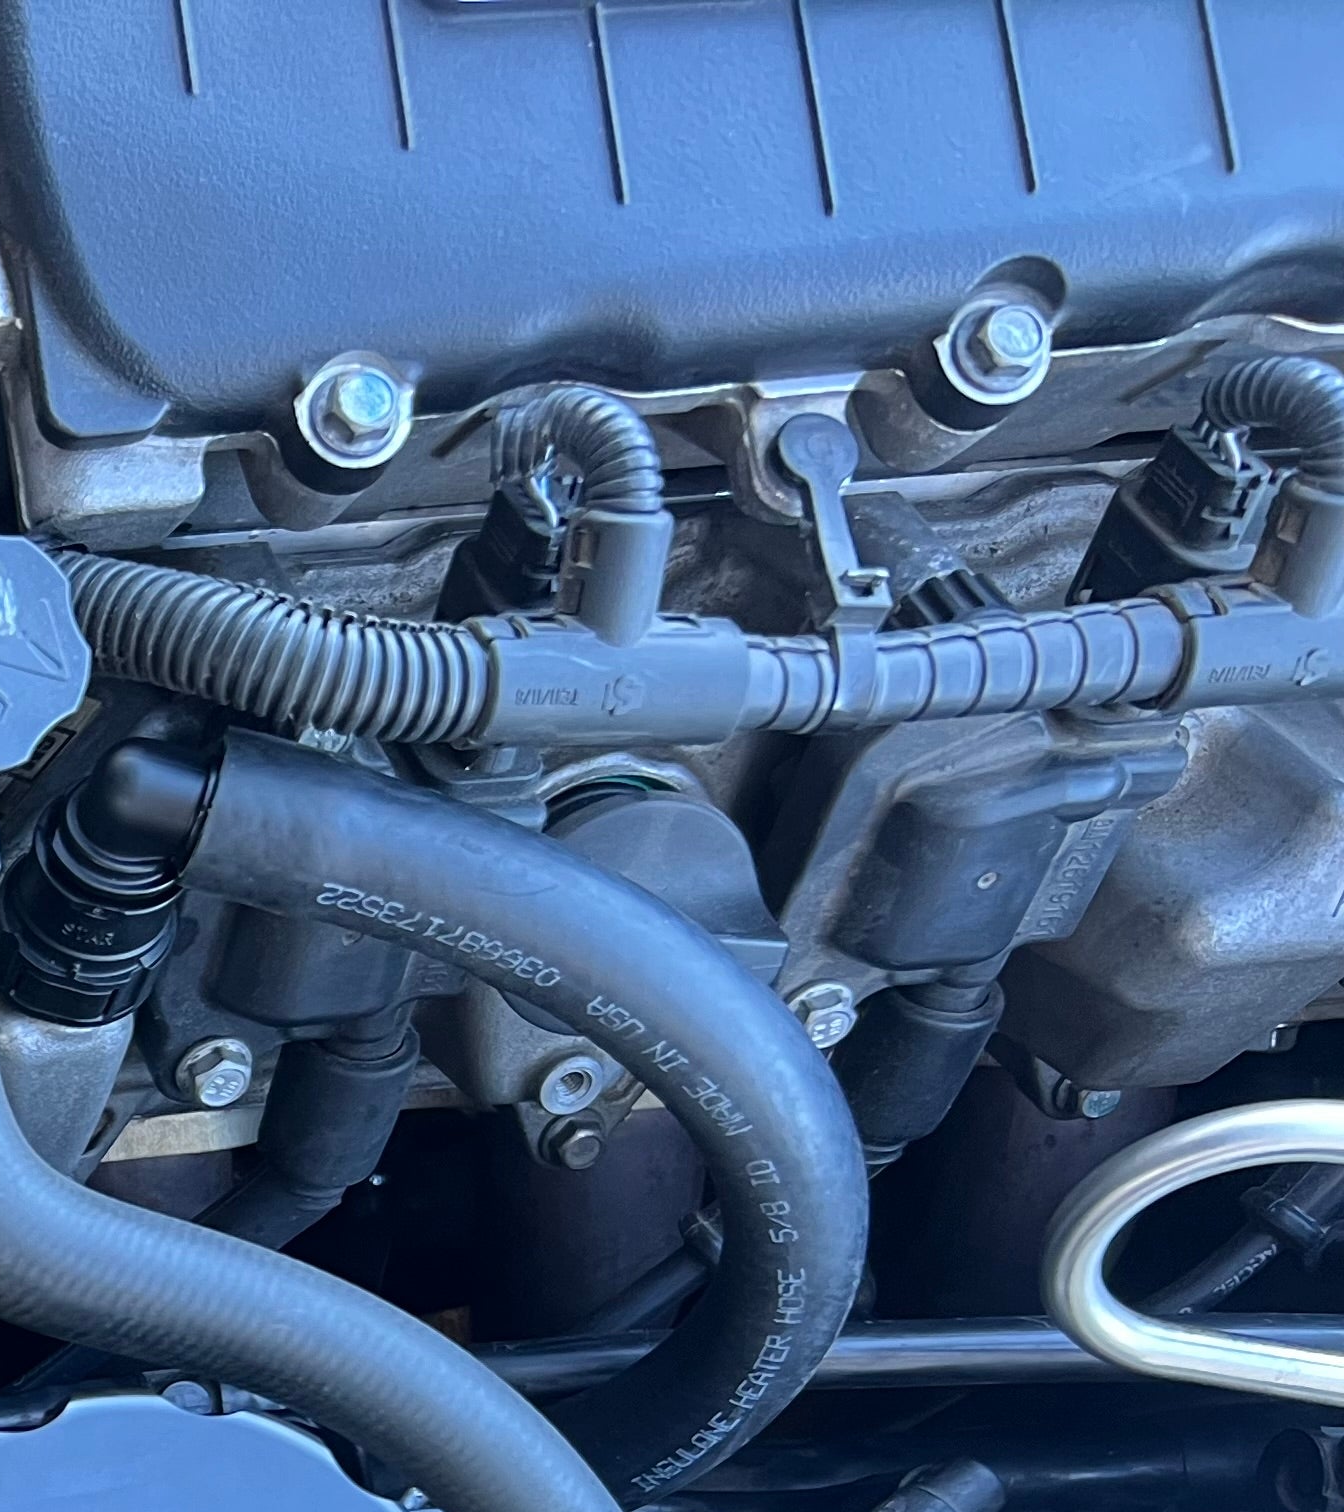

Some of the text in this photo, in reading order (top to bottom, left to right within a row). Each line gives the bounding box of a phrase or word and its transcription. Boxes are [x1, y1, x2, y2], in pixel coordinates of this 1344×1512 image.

[586, 995, 646, 1040] USA
[641, 1040, 689, 1073] IN
[682, 1076, 753, 1137] MADE
[746, 1159, 781, 1187] ID
[760, 1200, 799, 1244] 5/8
[773, 1267, 806, 1325] HOSE
[729, 1334, 793, 1409] HEATER
